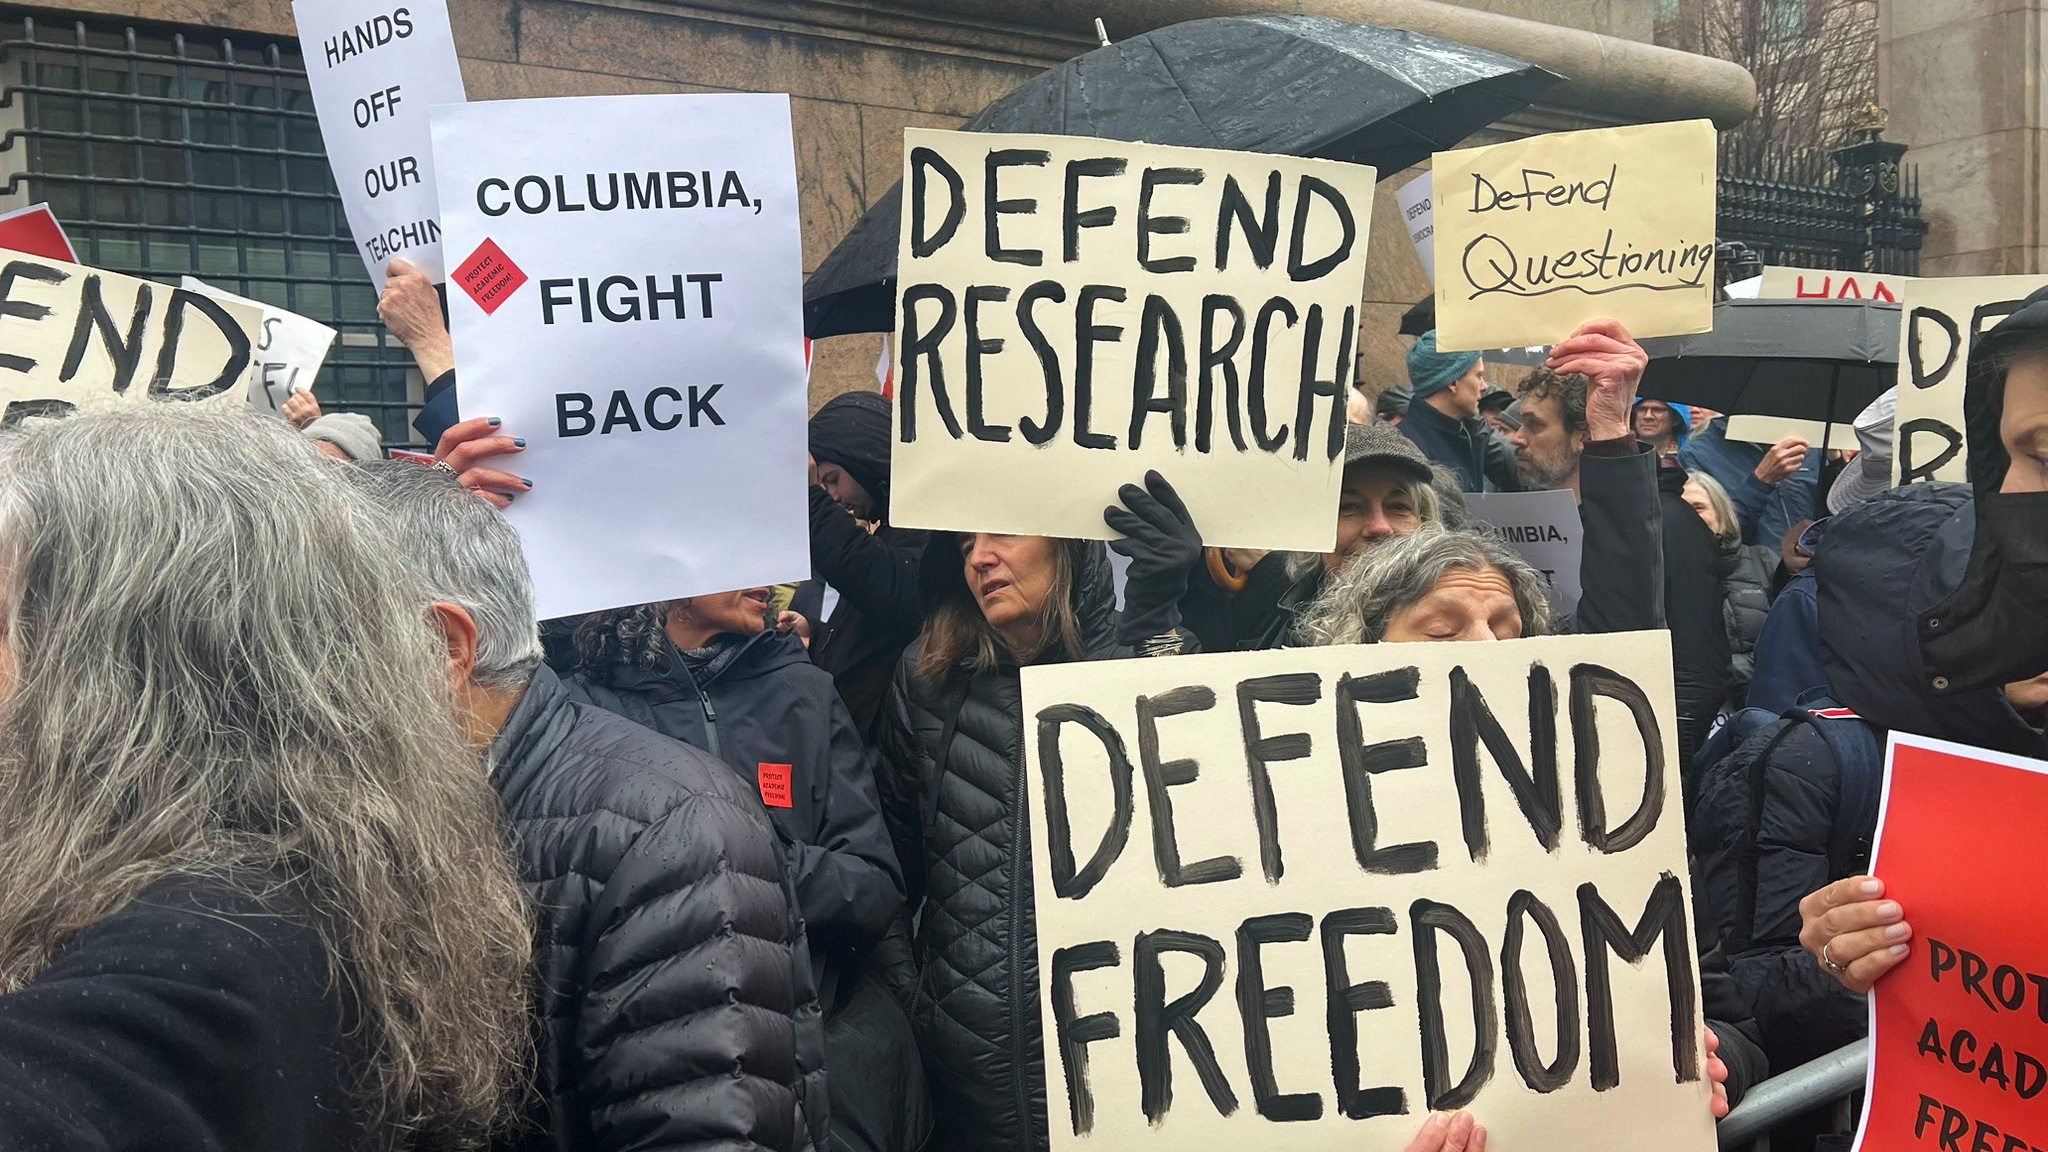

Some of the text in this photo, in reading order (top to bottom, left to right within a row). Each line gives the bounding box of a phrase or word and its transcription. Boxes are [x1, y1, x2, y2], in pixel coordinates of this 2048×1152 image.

[324, 7, 414, 69] HANDS
[353, 85, 402, 129] OFF
[364, 156, 421, 199] OUR
[476, 170, 762, 216] COLUMBIA,
[910, 146, 1356, 282] DEFEND
[465, 255, 493, 283] PROTECT
[473, 263, 504, 294] ACADEMIC
[481, 272, 513, 303] FREEDOM!
[1462, 229, 1713, 291] Questioning
[539, 273, 723, 324] FIGHT
[900, 279, 1354, 463] RESEARCH
[555, 383, 726, 438] BACK
[1036, 660, 1667, 899] DEFEND
[1051, 870, 1701, 1137] FREEDOM
[1917, 1017, 2048, 1100] ACAD
